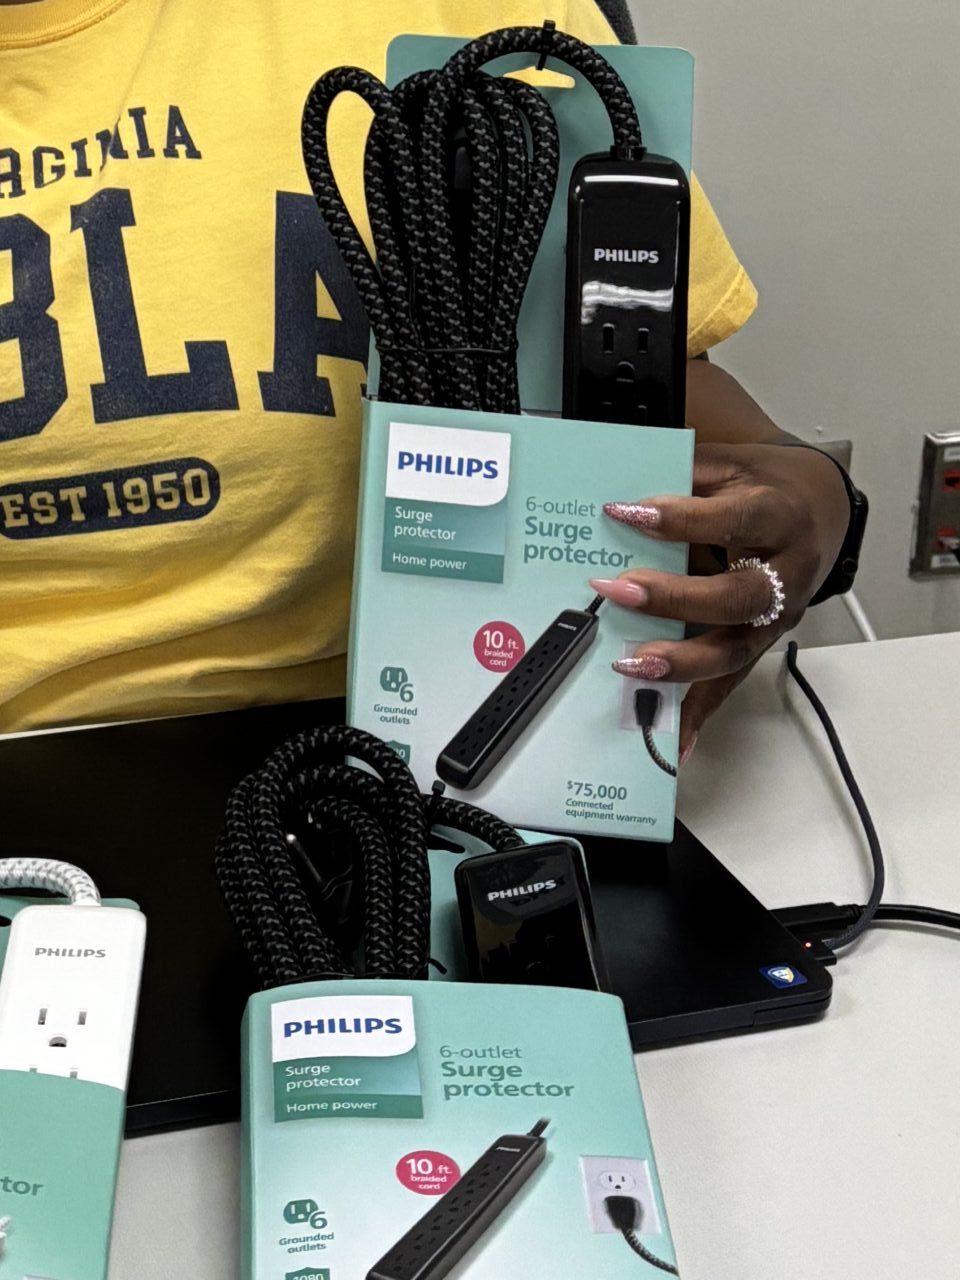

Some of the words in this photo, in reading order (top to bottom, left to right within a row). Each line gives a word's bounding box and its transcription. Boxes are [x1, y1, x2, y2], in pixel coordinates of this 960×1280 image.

[594, 249, 659, 263] PHILIPS
[398, 452, 498, 479] PHILIPS
[101, 470, 212, 521] 1950
[395, 506, 432, 524] Surge
[526, 496, 595, 520] 6-outlet
[395, 522, 456, 540] protector
[525, 516, 594, 543] Surge
[393, 553, 426, 565] Home
[430, 559, 466, 569] power
[524, 538, 635, 570] protector
[483, 630, 503, 650] 10
[508, 639, 518, 649] ft.
[484, 647, 515, 661] braided
[399, 682, 415, 703] 6
[374, 704, 417, 718] Grounded
[380, 714, 410, 724] outlets
[567, 781, 627, 802] $75,000
[566, 796, 615, 812] Connected
[566, 806, 614, 820] equipment
[616, 815, 656, 826] warranty
[488, 880, 556, 901] PHILIPS
[35, 948, 105, 958] PHILIPS
[284, 1018, 402, 1037] PHILIPS
[440, 1045, 522, 1058] 6-outlet
[285, 1062, 331, 1078] Surge
[441, 1061, 522, 1081] Surge
[286, 1074, 361, 1092] protector
[444, 1080, 574, 1100] protector
[287, 1103, 328, 1112] Home
[332, 1102, 377, 1110] power
[407, 1159, 432, 1176] 10
[438, 1165, 452, 1174] ft.
[411, 1173, 448, 1185] braided
[309, 1210, 329, 1229] 6
[279, 1232, 335, 1245] Grounded
[287, 1243, 327, 1254] outlets
